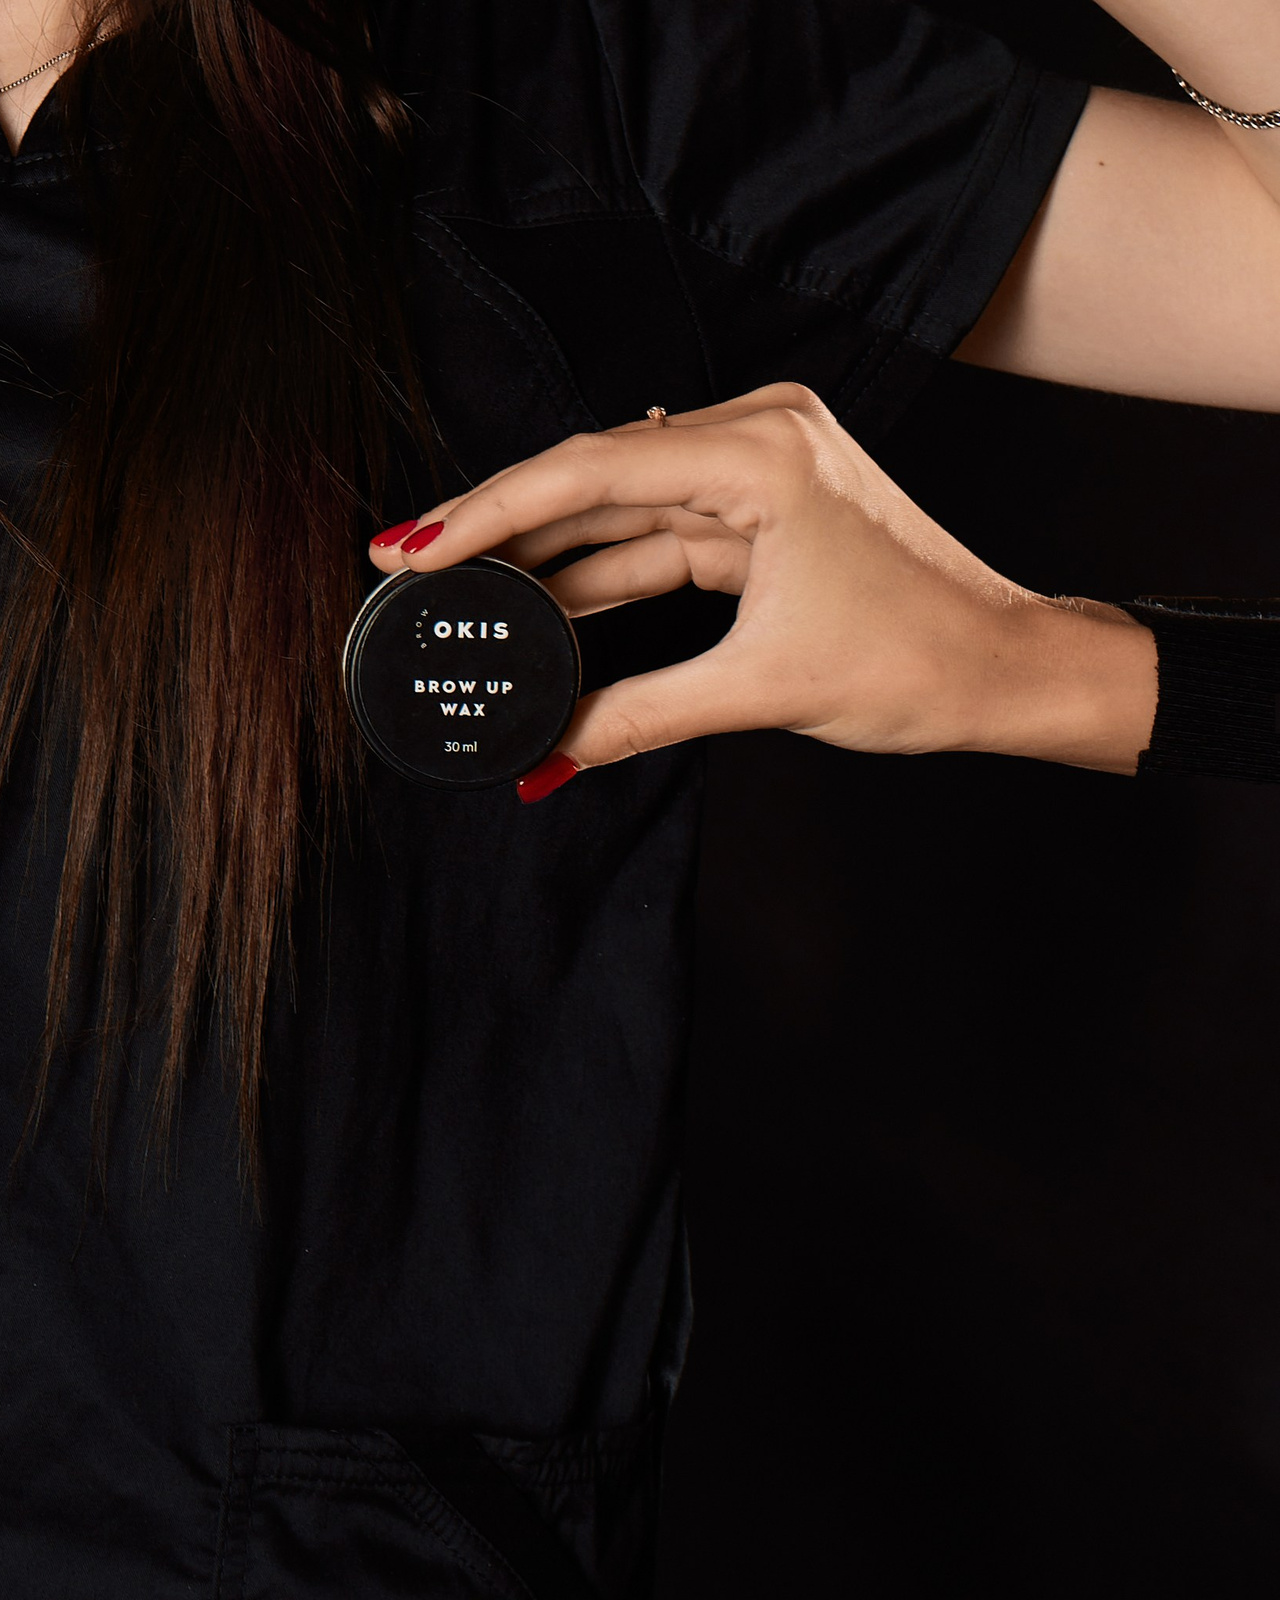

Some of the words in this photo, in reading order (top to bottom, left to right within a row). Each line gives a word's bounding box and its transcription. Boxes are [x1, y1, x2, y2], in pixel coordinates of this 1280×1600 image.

[433, 620, 510, 640] OKIS
[414, 679, 477, 694] BROW
[486, 681, 513, 695] UP
[440, 702, 486, 717] WAX
[444, 741, 460, 753] 30
[462, 740, 478, 753] ml
